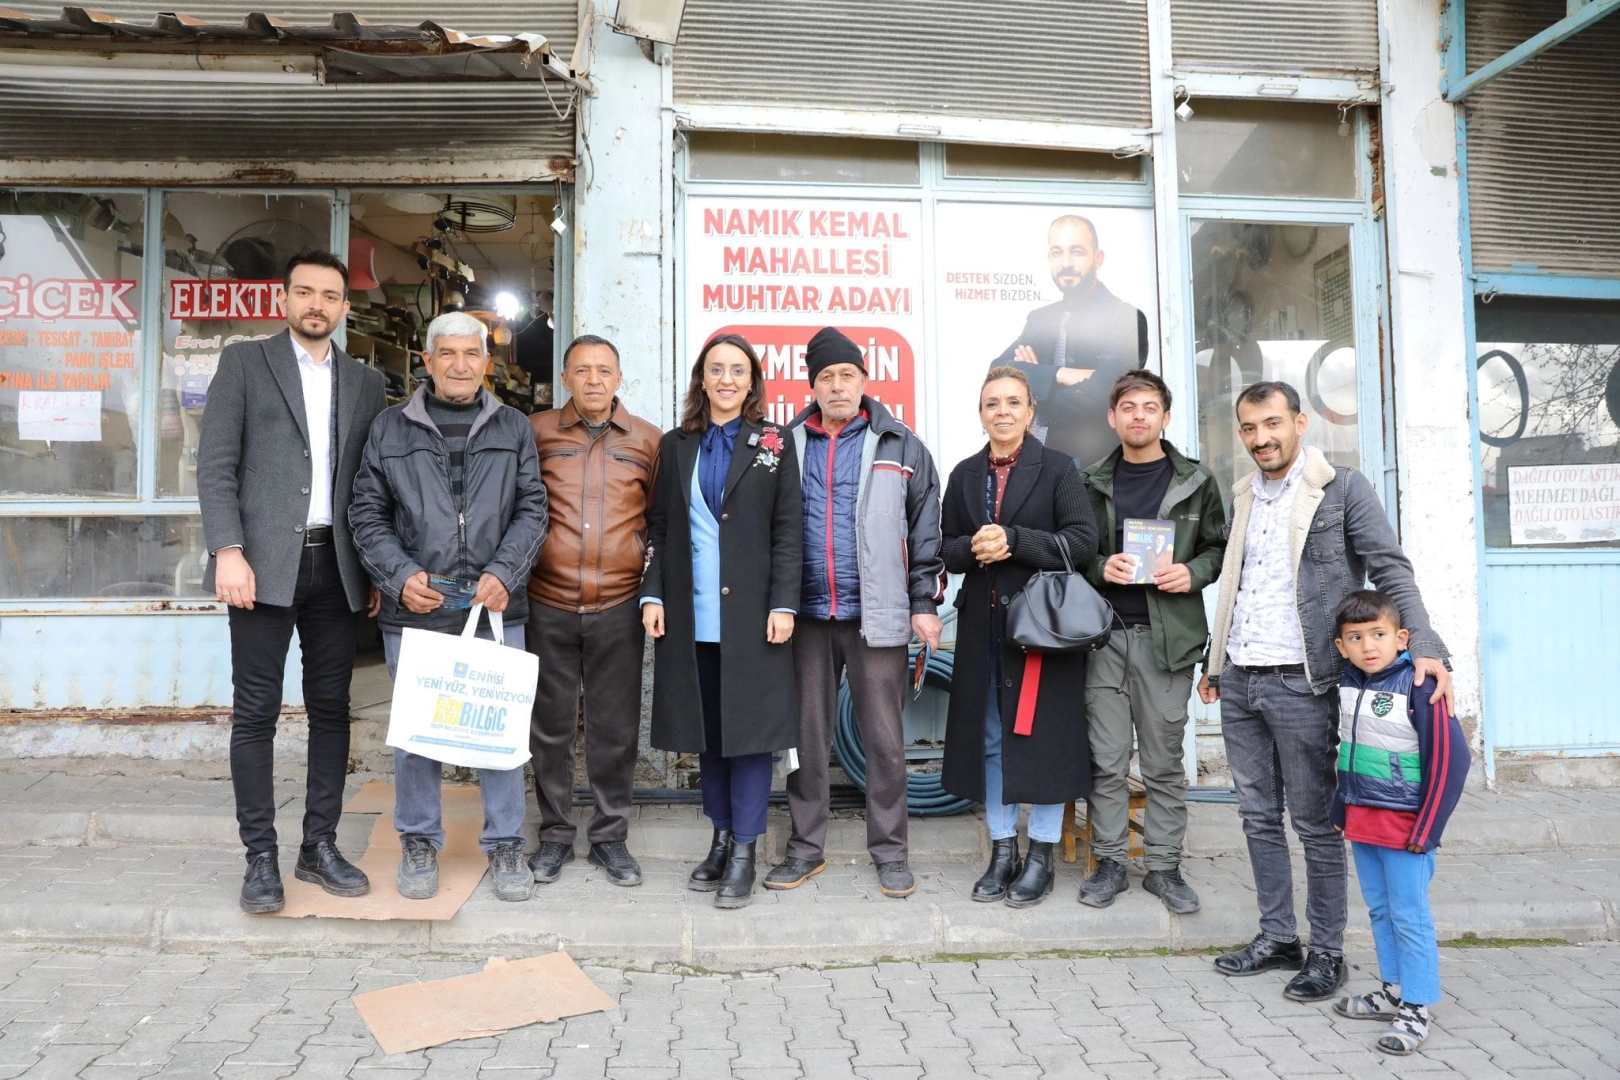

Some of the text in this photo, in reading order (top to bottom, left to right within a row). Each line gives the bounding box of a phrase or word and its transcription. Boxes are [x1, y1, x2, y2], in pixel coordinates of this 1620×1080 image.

[703, 208, 910, 239] NAMIK KEMAL
[723, 244, 891, 276] MAHALLESİ
[946, 272, 991, 284] DESTEK
[171, 281, 287, 320] ELEKTR
[703, 284, 912, 314] MUHTAR ADAYI
[174, 335, 222, 349] Erol
[65, 352, 95, 368] PANO
[61, 371, 111, 389] YAPILIR
[1513, 468, 1551, 484] DAĞLI
[1553, 468, 1578, 483] OTO
[1514, 485, 1620, 504] MEHMET DAĞL
[1515, 504, 1551, 523] DAĞLI
[1553, 507, 1580, 521] OTO
[416, 676, 443, 690] YENİ
[469, 670, 486, 682] EN
